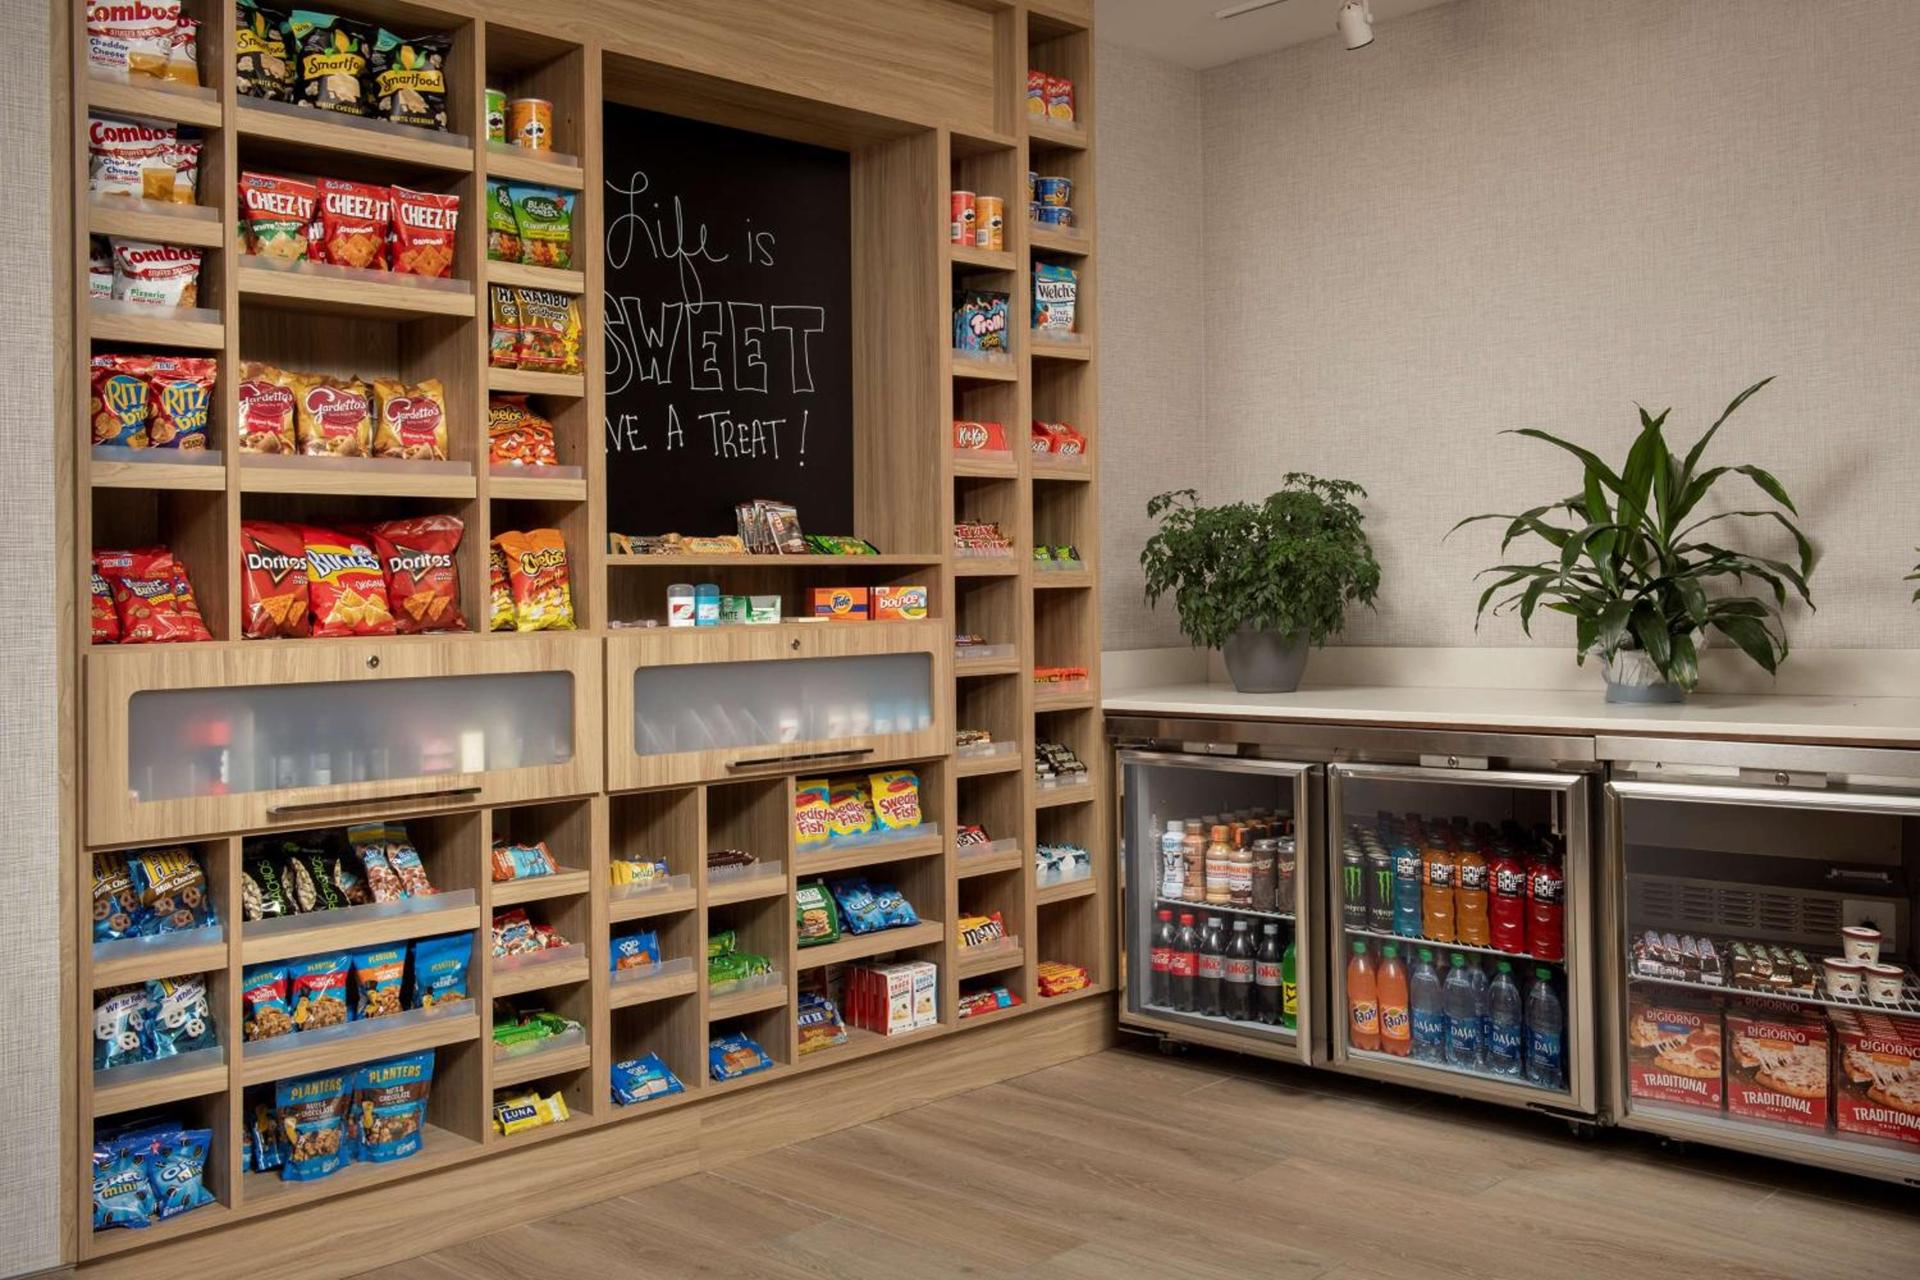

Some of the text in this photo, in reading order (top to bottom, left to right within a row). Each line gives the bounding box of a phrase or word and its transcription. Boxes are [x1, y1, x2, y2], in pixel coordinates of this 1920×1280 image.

[308, 57, 360, 75] Smartfo
[382, 71, 440, 94] Smartfood
[89, 121, 177, 145] Combos
[605, 171, 775, 314] Life is
[116, 246, 202, 265] Combos
[130, 288, 167, 300] Pizzeria
[520, 288, 569, 309] HARIBO
[1038, 282, 1076, 300] Welch's
[970, 310, 1006, 336] Trolli
[602, 289, 824, 395] SWEET
[106, 379, 149, 412] RITZ
[163, 386, 208, 416] RITZ
[666, 404, 684, 450] A
[248, 552, 307, 571] Doritos
[389, 554, 451, 573] Doritos
[833, 594, 851, 609] Tide
[880, 594, 920, 609] bounce
[892, 805, 918, 821] Fish
[798, 821, 826, 835] Fish
[1414, 1019, 1443, 1034] DASAN
[1493, 1031, 1521, 1047] DASAN
[369, 1065, 422, 1084] PLANTERS
[291, 1078, 343, 1101] PLANTERS
[1643, 1073, 1708, 1096] TRADITIONAL
[1742, 1090, 1813, 1115] TRADITIONAL
[504, 1107, 535, 1121] LUNA
[1853, 1107, 1920, 1130] TRADITIONA
